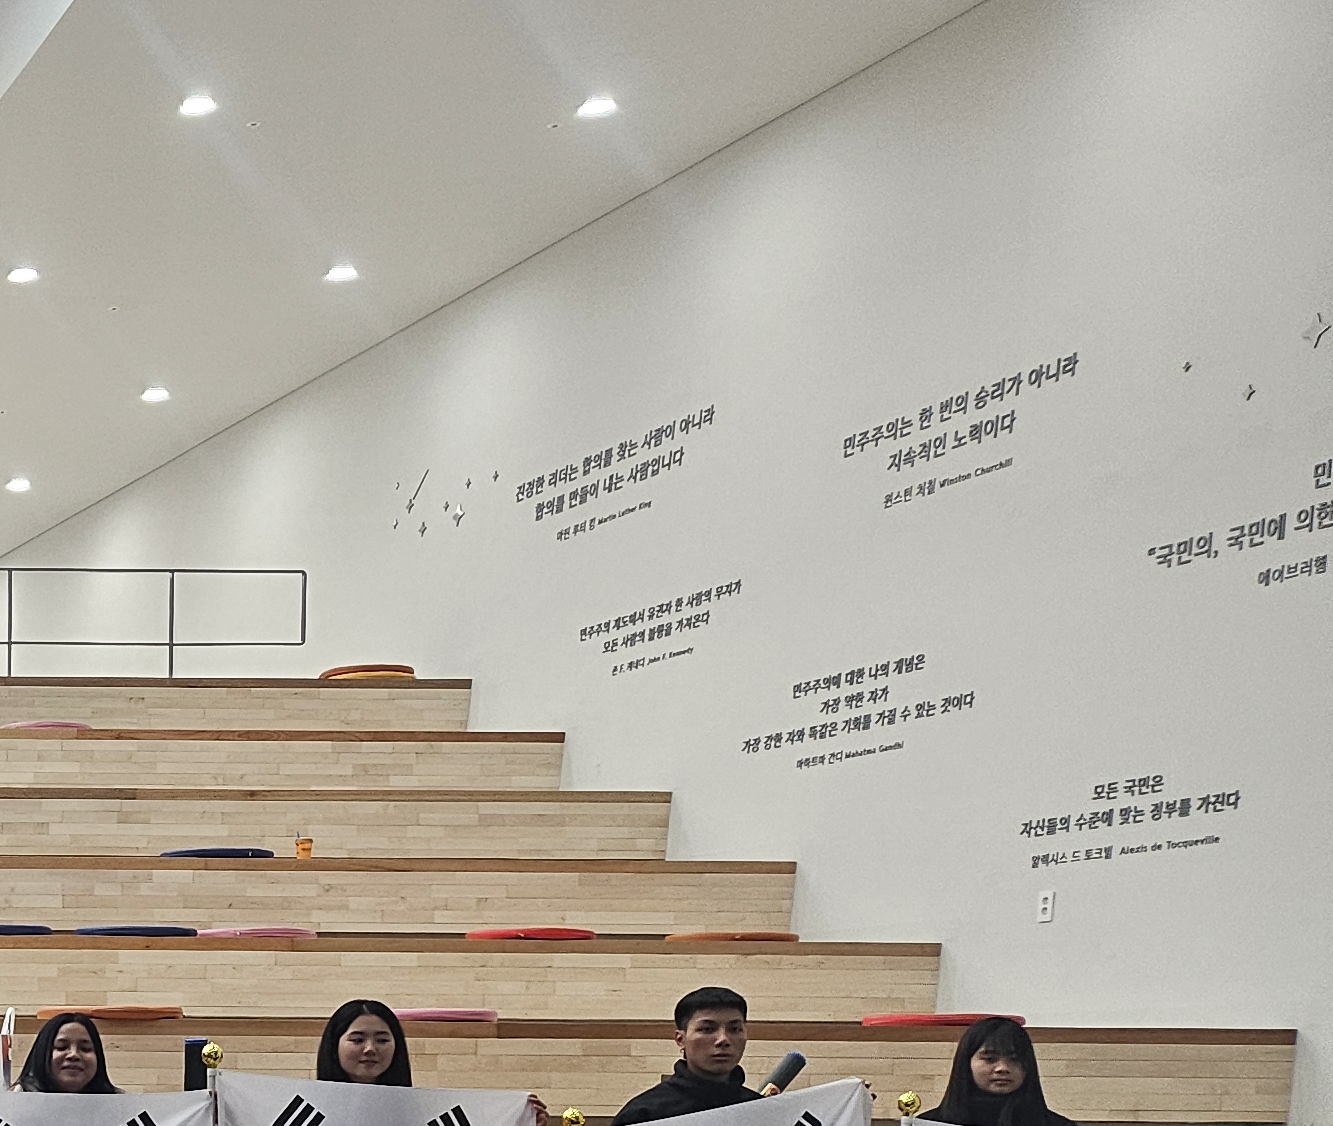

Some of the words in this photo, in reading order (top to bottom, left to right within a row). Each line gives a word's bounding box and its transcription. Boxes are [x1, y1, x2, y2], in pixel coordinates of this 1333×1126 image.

[843, 416, 913, 458] 민주주의는
[919, 405, 933, 430] 한
[939, 391, 969, 423] 번의
[973, 372, 1023, 410] 승리가
[1028, 352, 1079, 389] 아니라
[516, 474, 545, 503] 진정한
[548, 464, 579, 488] 리더는
[582, 447, 613, 476] 합의를
[616, 439, 638, 462] 찾는
[641, 420, 676, 449] 사람이
[679, 404, 715, 435] 아니라
[887, 432, 947, 472] 지속적인
[951, 410, 1016, 449] 노력이다
[535, 494, 565, 521] 합의를
[603, 473, 624, 493] 내는
[627, 446, 685, 484] 사람입니다
[939, 471, 971, 489] Winston
[974, 457, 1013, 477] Churchill
[597, 513, 616, 525] Martin
[1226, 512, 1287, 551] 국민에
[580, 620, 610, 642] 민주주의
[675, 597, 683, 612] 한
[685, 588, 712, 608] 사람의
[714, 579, 742, 600] 무지가
[602, 638, 618, 653] 모든
[620, 629, 645, 649] 사람의
[793, 673, 841, 699] 민주주의에
[845, 668, 865, 686] 대한
[869, 661, 890, 680] 나의
[892, 654, 926, 675] 개념은
[820, 697, 841, 715] 가장
[844, 691, 864, 710] 약한
[867, 686, 889, 704] 자가
[741, 737, 760, 754] 가장
[764, 732, 783, 750] 강한
[785, 728, 805, 744] 자와
[809, 722, 838, 742] 똑같은
[841, 714, 872, 734] 기회를
[875, 707, 896, 726] 가질
[900, 706, 911, 722] 수
[915, 701, 936, 719] 있는
[940, 691, 975, 714] 것이다
[879, 741, 904, 753] Gandhi
[1091, 781, 1119, 800] 모든
[1123, 775, 1165, 797] 국민은
[1020, 815, 1071, 838] 자신들의
[1074, 808, 1114, 831] 수준에
[1119, 806, 1145, 826] 맞는
[1150, 798, 1192, 821] 정부를
[1196, 790, 1241, 814] 가진다
[1070, 850, 1081, 863] 드
[1119, 844, 1148, 856] Alexis
[1151, 843, 1163, 852] de
[1166, 835, 1220, 851] Tocqueville
